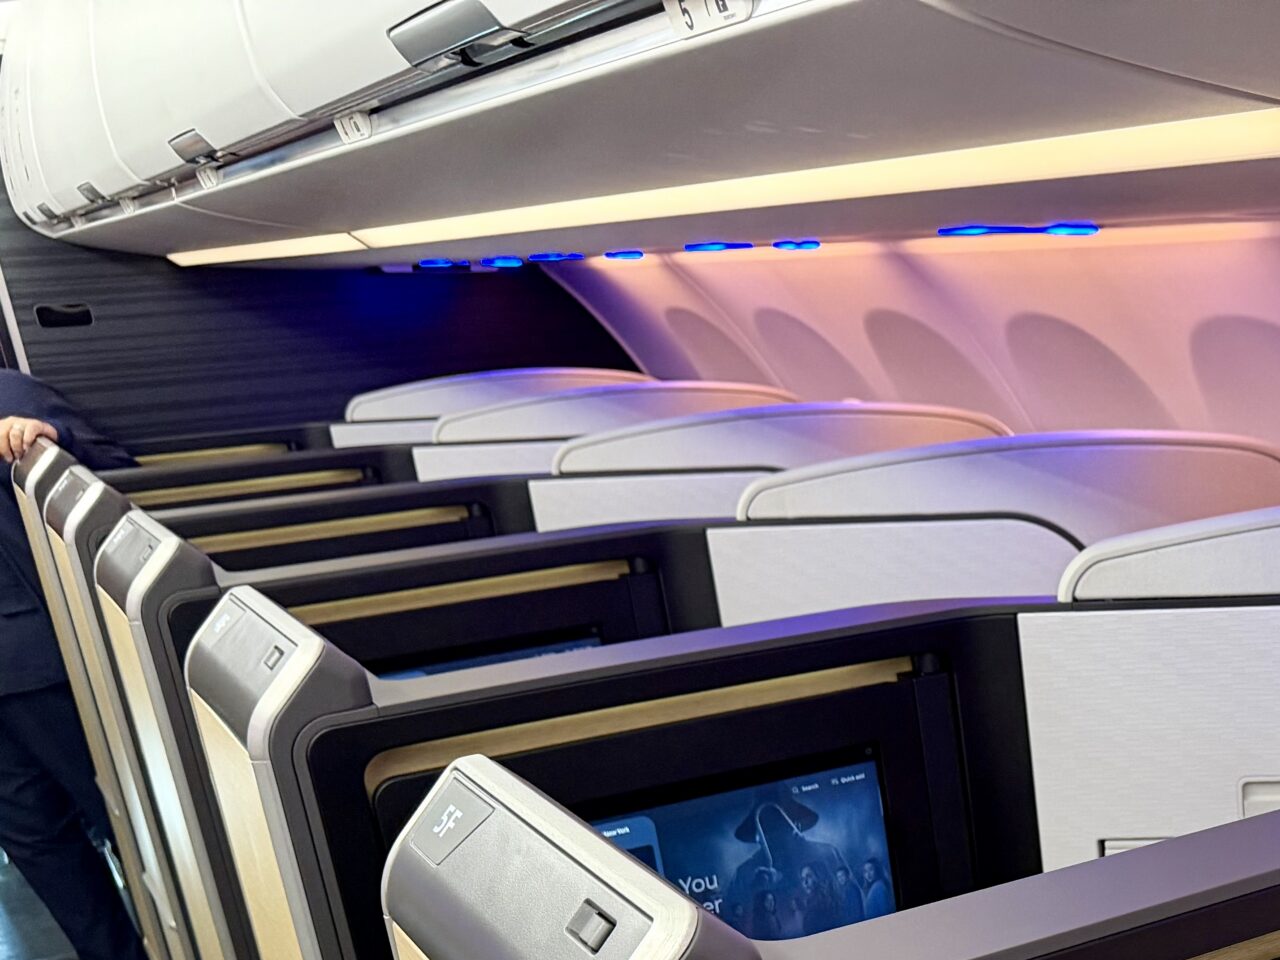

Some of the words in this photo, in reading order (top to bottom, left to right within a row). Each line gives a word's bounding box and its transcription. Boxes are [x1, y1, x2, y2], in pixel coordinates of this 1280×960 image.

[801, 783, 819, 792] Search
[432, 804, 464, 838] 5F
[617, 826, 630, 835] York
[678, 874, 719, 895] You
